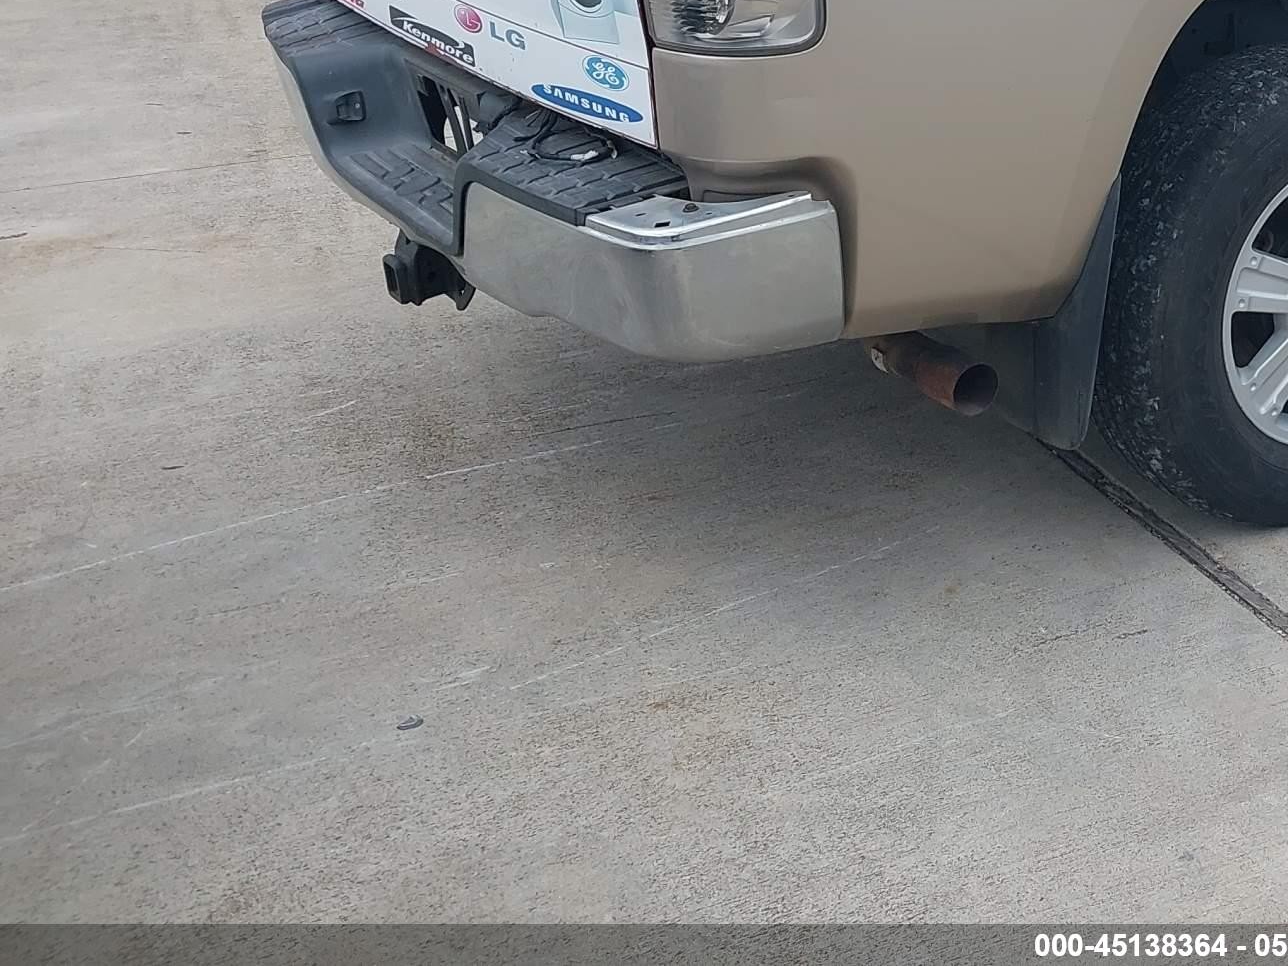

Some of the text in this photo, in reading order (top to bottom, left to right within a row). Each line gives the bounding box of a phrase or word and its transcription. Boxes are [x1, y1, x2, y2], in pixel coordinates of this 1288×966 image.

[402, 21, 475, 64] Kenmore
[489, 21, 526, 50] LG
[543, 84, 630, 122] SAMSUNG
